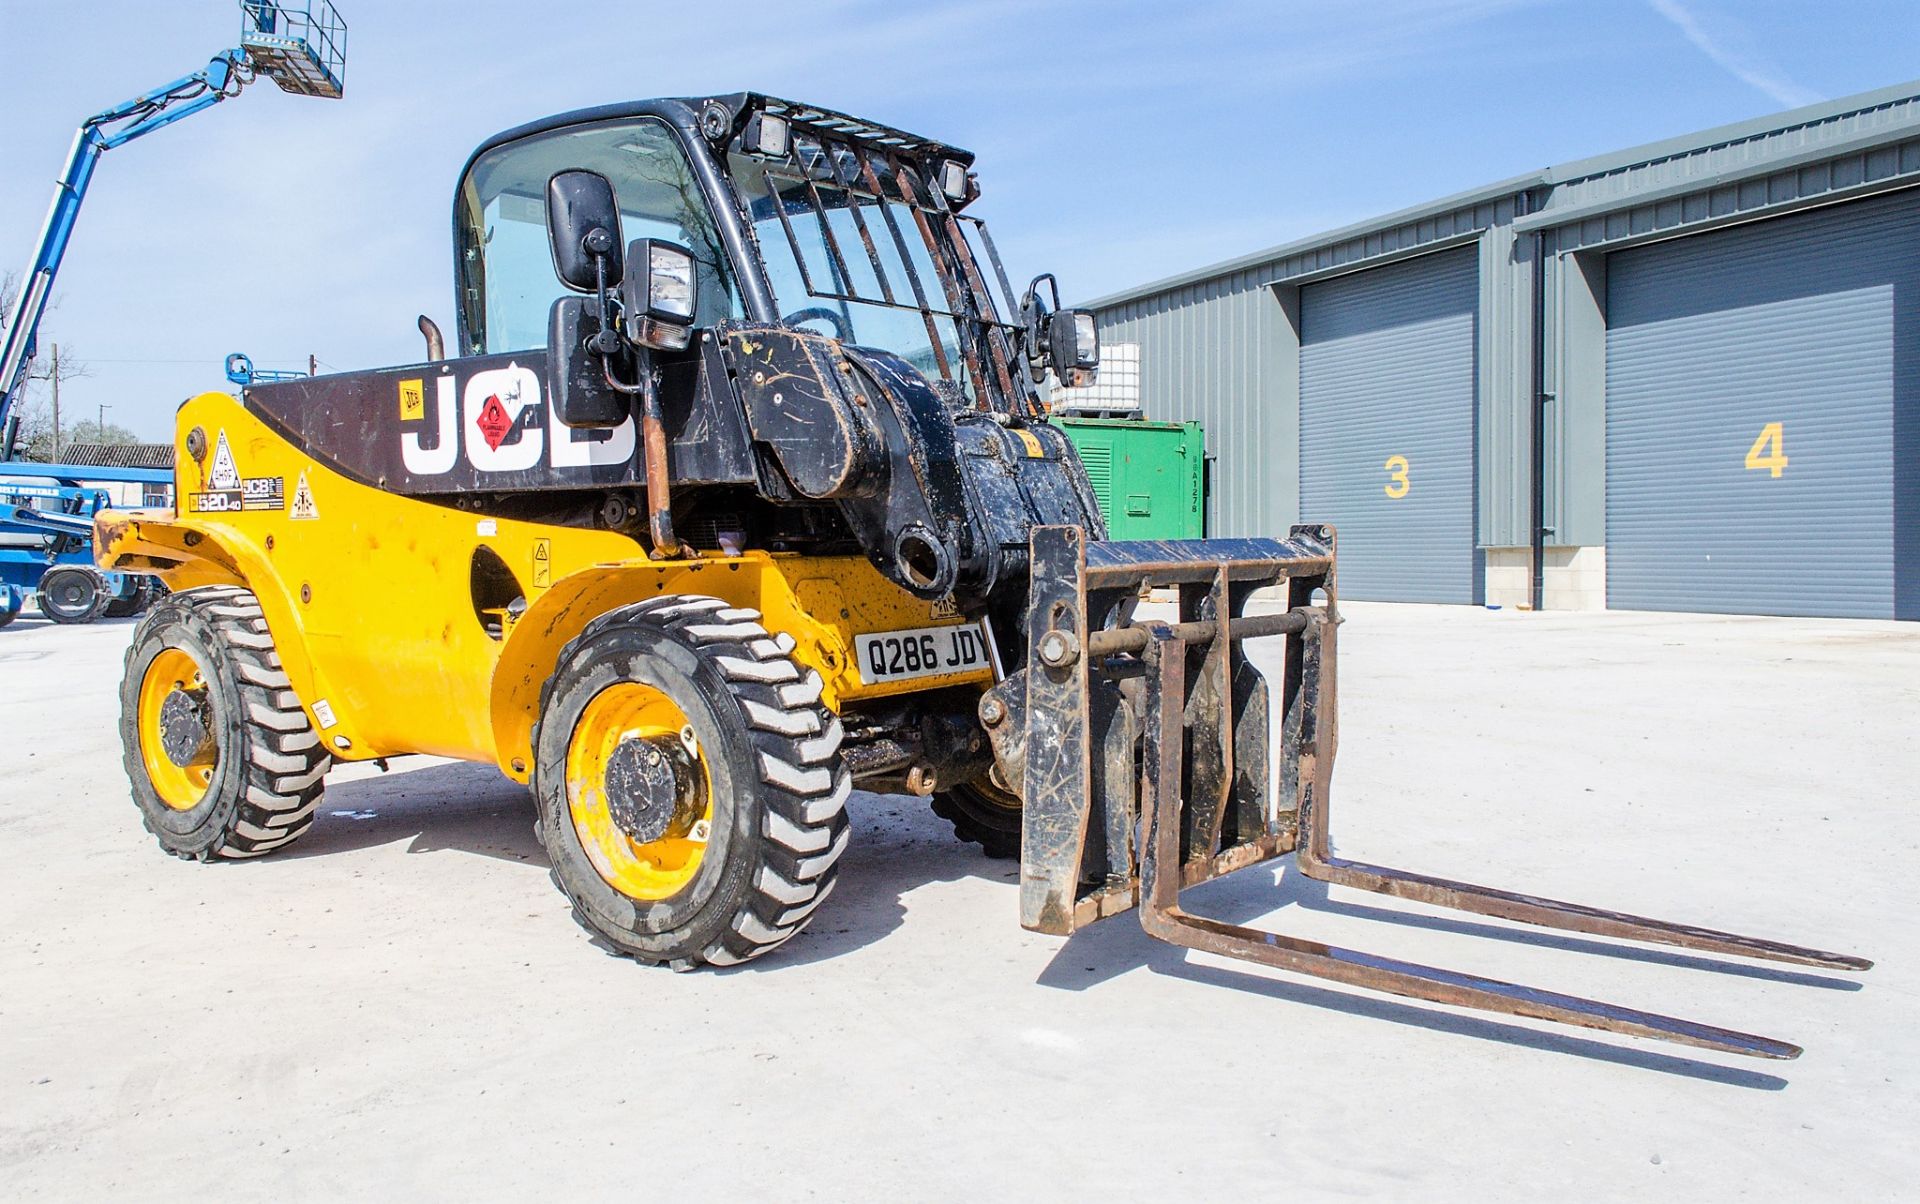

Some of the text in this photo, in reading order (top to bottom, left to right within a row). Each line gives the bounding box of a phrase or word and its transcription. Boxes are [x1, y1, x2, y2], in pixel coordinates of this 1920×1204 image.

[1744, 422, 1789, 478] 4
[243, 479, 269, 494] JCB
[1384, 454, 1409, 498] 3
[868, 635, 938, 676] Q286
